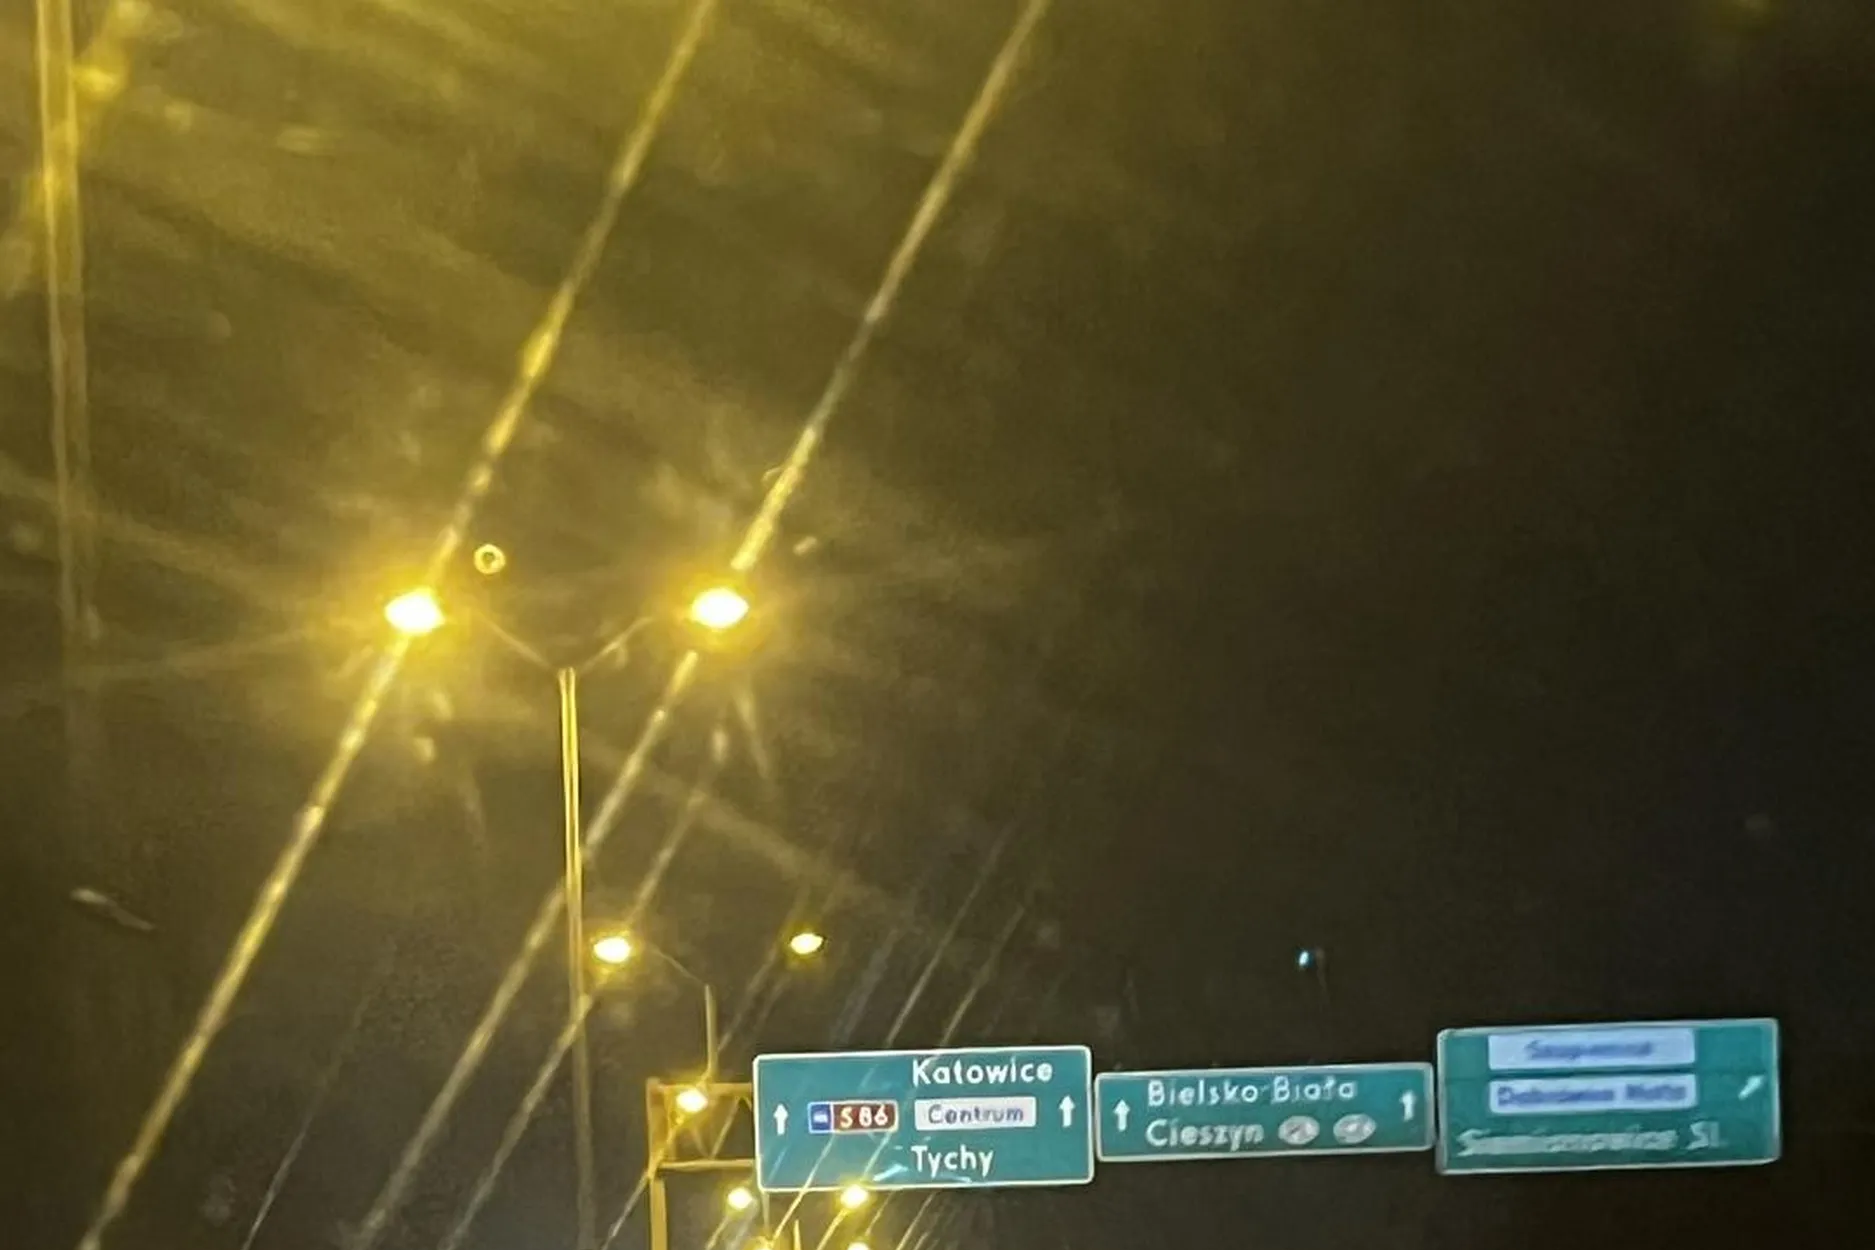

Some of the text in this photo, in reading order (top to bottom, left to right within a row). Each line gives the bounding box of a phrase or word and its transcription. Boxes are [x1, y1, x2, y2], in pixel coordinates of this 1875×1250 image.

[911, 1056, 1054, 1087] Katowice
[928, 1103, 1024, 1125] Centrum
[1145, 1118, 1265, 1152] Cieszyn
[911, 1145, 995, 1178] Tychy
